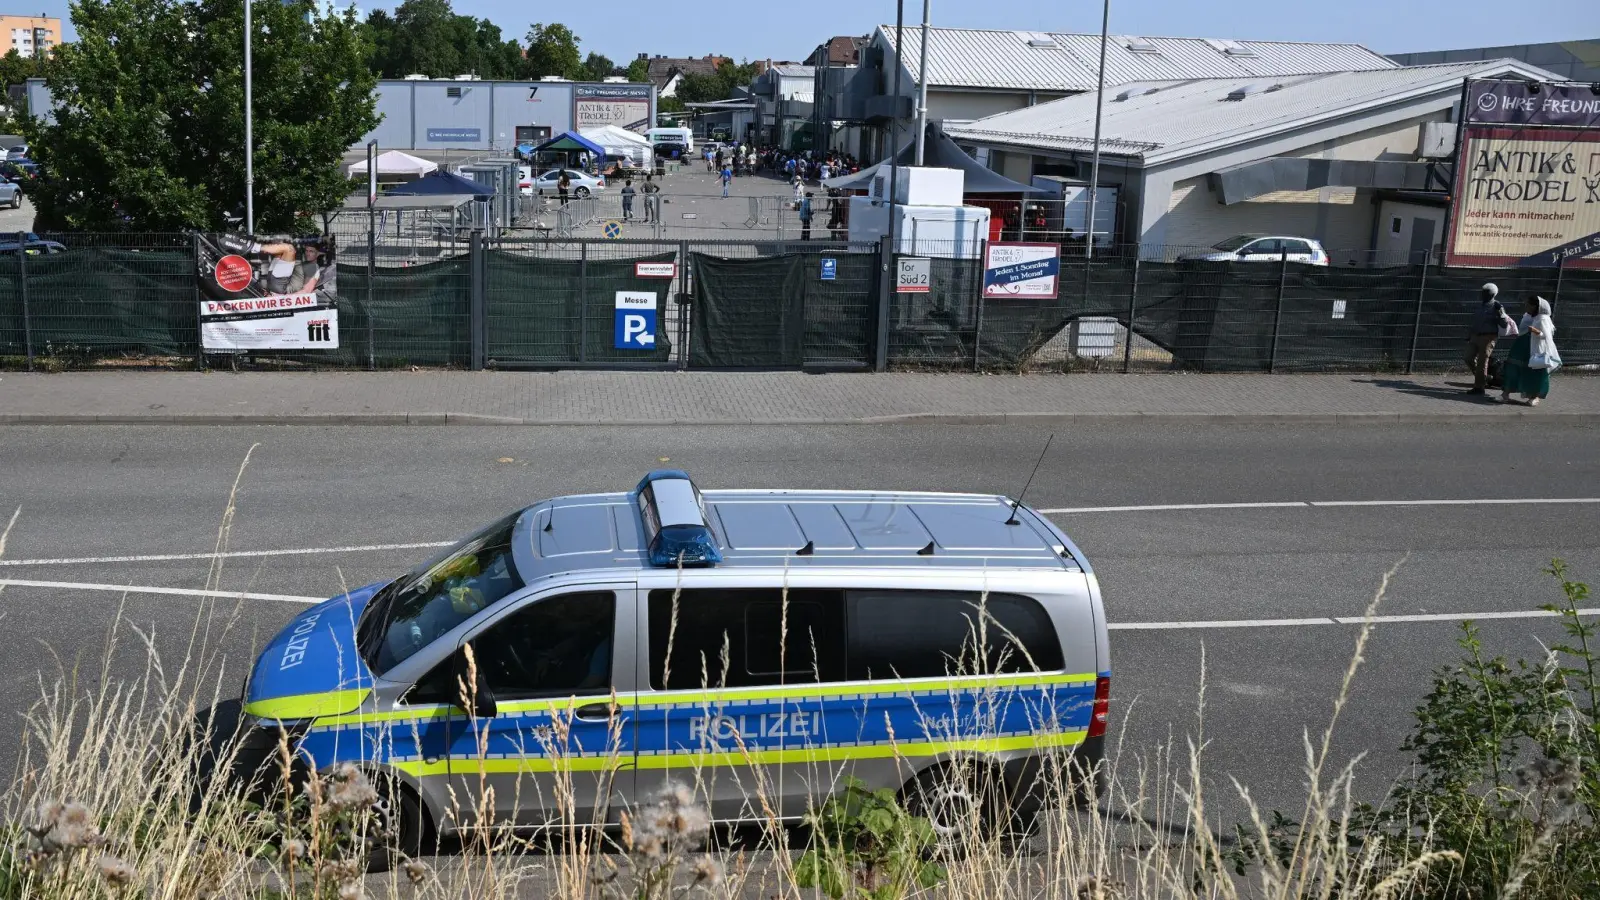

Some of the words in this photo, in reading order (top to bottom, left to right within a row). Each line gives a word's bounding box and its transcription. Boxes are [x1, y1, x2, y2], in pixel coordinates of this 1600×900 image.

[530, 86, 539, 99] 7
[579, 104, 604, 112] ANTIK
[1502, 95, 1536, 111] IHRE
[1473, 150, 1559, 174] ANTIK
[1561, 152, 1577, 174] &
[1470, 178, 1577, 202] TRÖDEL
[1466, 209, 1490, 218] Jeder
[1492, 209, 1515, 219] kann
[1518, 211, 1575, 221] mitmachen!
[1463, 231, 1563, 239] www.antik-troedel-markt.de
[900, 261, 915, 271] Tor
[995, 268, 1014, 278] Jeden
[1020, 261, 1050, 271] Sonntag
[1021, 269, 1043, 279] Monat
[900, 273, 918, 284] Süd
[920, 274, 927, 284] 2
[208, 301, 253, 312] PACKEN
[256, 299, 277, 309] WIR
[280, 297, 292, 307] ES
[295, 296, 314, 306] AN.
[624, 296, 648, 304] Messe
[307, 323, 331, 342] fit
[624, 314, 647, 343] P
[279, 613, 321, 671] POLIZEI
[689, 711, 820, 741] POLIZEI
